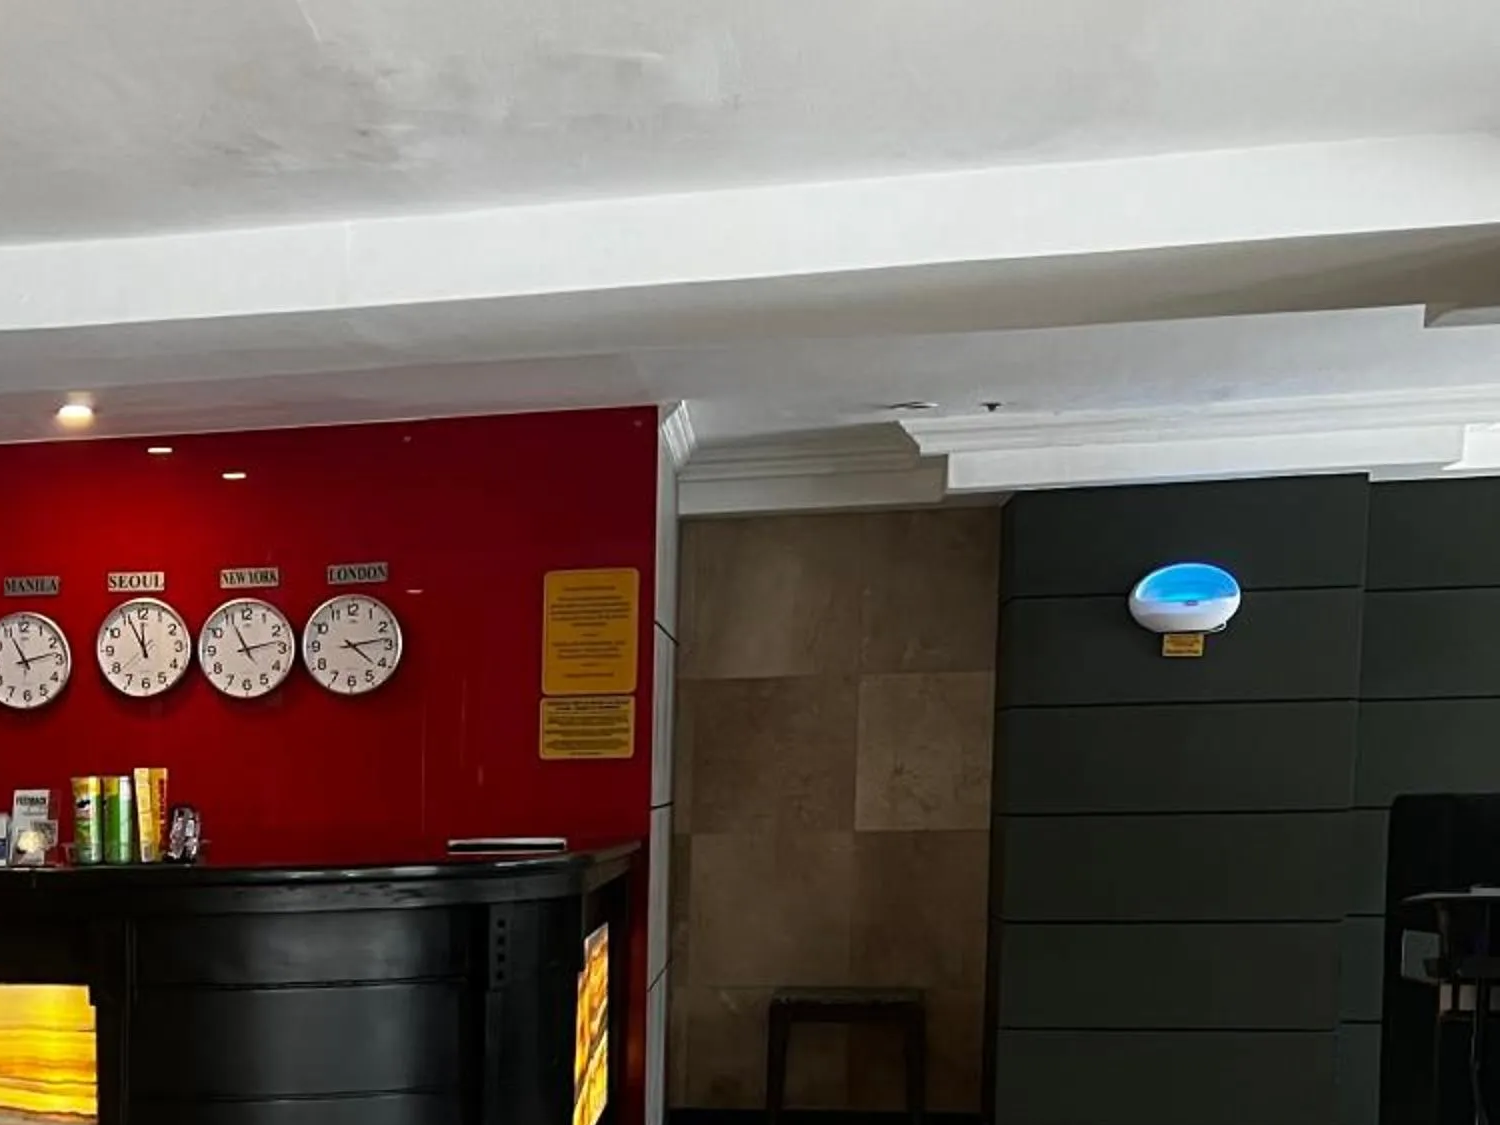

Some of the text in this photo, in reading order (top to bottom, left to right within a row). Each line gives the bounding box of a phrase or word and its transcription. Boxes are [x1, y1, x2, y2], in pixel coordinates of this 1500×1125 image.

[222, 568, 277, 585] NEW YORK
[328, 564, 387, 584] LONDON
[4, 577, 58, 592] MANILA
[108, 574, 164, 589] SEOUL
[137, 607, 149, 621] 12
[241, 608, 253, 621] 12
[347, 603, 359, 616] 12
[18, 621, 29, 633] 12
[110, 627, 121, 639] 10
[167, 623, 177, 636] 2
[211, 627, 223, 639] 10
[271, 624, 281, 638] 2
[317, 622, 329, 635] 10
[378, 621, 388, 633] 2
[48, 636, 57, 649] 2
[174, 639, 183, 653] 3
[277, 641, 287, 655] 3
[311, 640, 321, 653] 9
[384, 638, 393, 651] 3
[105, 645, 115, 657] 9
[207, 645, 217, 656] 9
[55, 652, 64, 666] 3
[169, 658, 178, 669] 4
[271, 660, 280, 671] 4
[317, 658, 327, 671] 8
[377, 657, 387, 668] 4
[112, 662, 121, 674] 8
[213, 662, 223, 674] 8
[49, 671, 59, 682] 4
[125, 673, 133, 686] 7
[157, 671, 167, 684] 5
[226, 673, 235, 686] 7
[260, 673, 269, 685] 5
[330, 670, 339, 683] 7
[347, 675, 357, 687] 6
[365, 669, 375, 682] 5
[141, 677, 151, 689] 6
[242, 679, 252, 691] 6
[7, 685, 17, 698] 7
[23, 689, 33, 702] 6
[39, 683, 49, 697] 5
